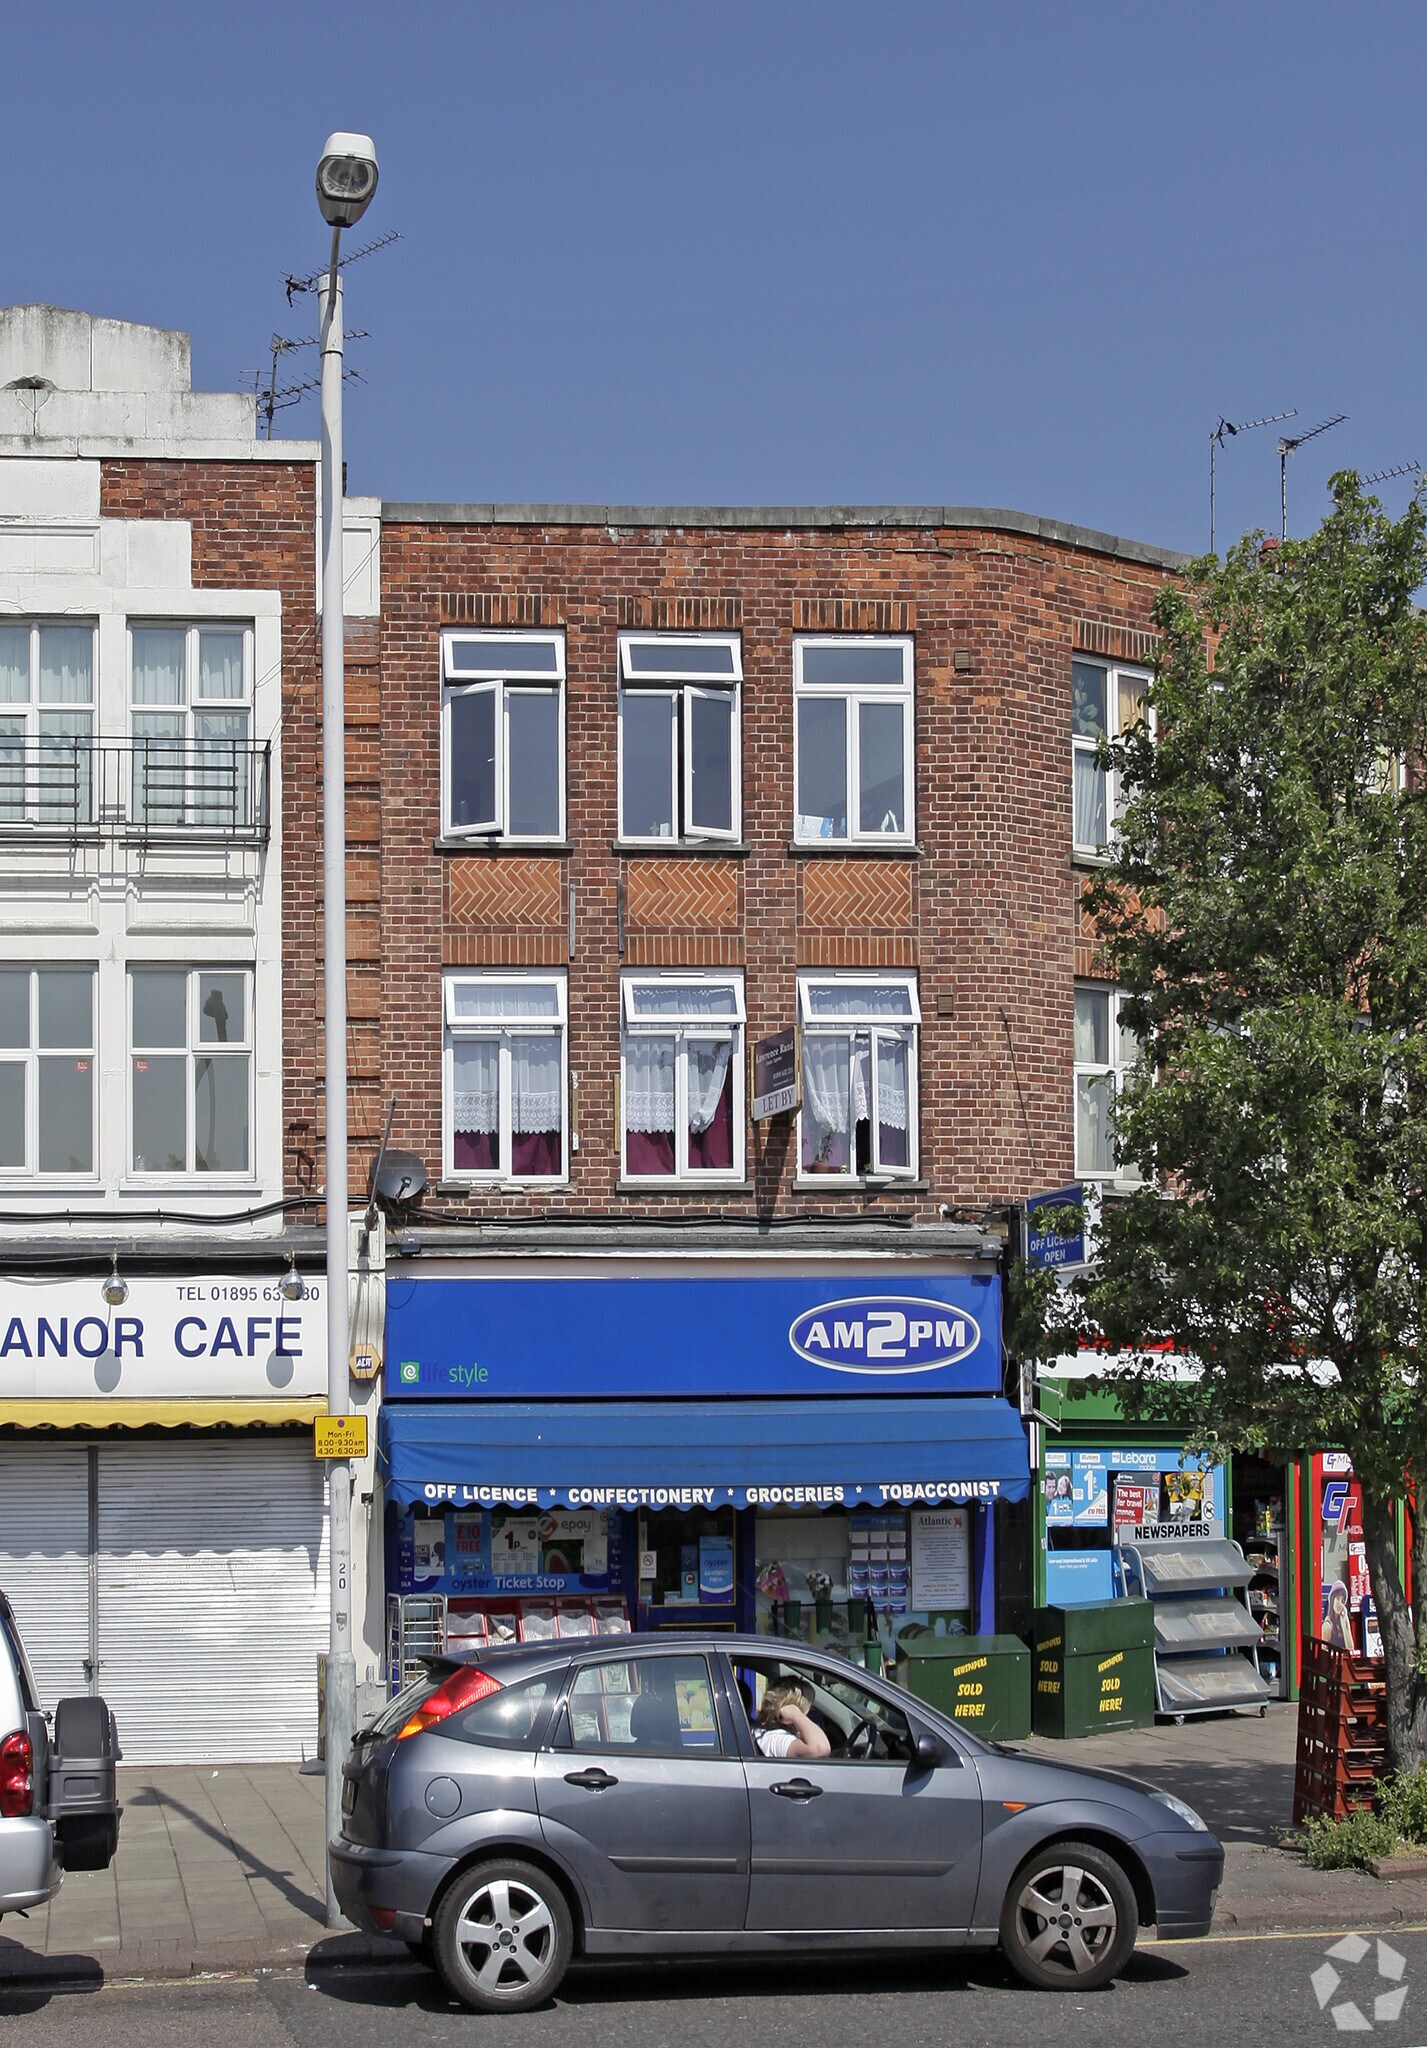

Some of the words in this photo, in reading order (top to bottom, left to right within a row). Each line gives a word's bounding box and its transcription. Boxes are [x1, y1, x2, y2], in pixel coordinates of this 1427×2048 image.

[762, 1094, 779, 1114] LET
[781, 1089, 794, 1107] BY
[1030, 1238, 1045, 1251] OFF
[1044, 1249, 1066, 1262] OPEN
[176, 1287, 206, 1301] TEL
[211, 1287, 257, 1301] 01895
[174, 1316, 303, 1358] CAFE
[804, 1311, 966, 1357] AM2PM
[356, 1357, 372, 1368] ADT
[421, 1362, 488, 1387] lifestyle
[1121, 1451, 1156, 1464] Lebara
[424, 1484, 457, 1499] OFF
[463, 1485, 538, 1502] LICENCE
[568, 1488, 715, 1504] CONFECTIONERY
[745, 1486, 845, 1503] GROCERIES
[878, 1481, 1000, 1500] TOBACCONIST
[1117, 1488, 1128, 1497] The
[1129, 1490, 1141, 1498] best
[561, 1519, 592, 1533] epay
[919, 1515, 952, 1526] Atlantic
[1135, 1524, 1210, 1540] NEWSPAPERS
[456, 1540, 481, 1553] FREE
[452, 1577, 490, 1592] oyster
[494, 1576, 533, 1590] Ticket
[536, 1575, 565, 1591] Stop
[953, 1657, 988, 1677] NEWSPAPERS
[1040, 1660, 1058, 1673] SOLD
[957, 1683, 983, 1697] SOLD
[1038, 1680, 1060, 1693] HERE!
[1101, 1677, 1120, 1692] SOLD
[954, 1703, 986, 1717] HERE!
[1099, 1697, 1123, 1713] HERE!
